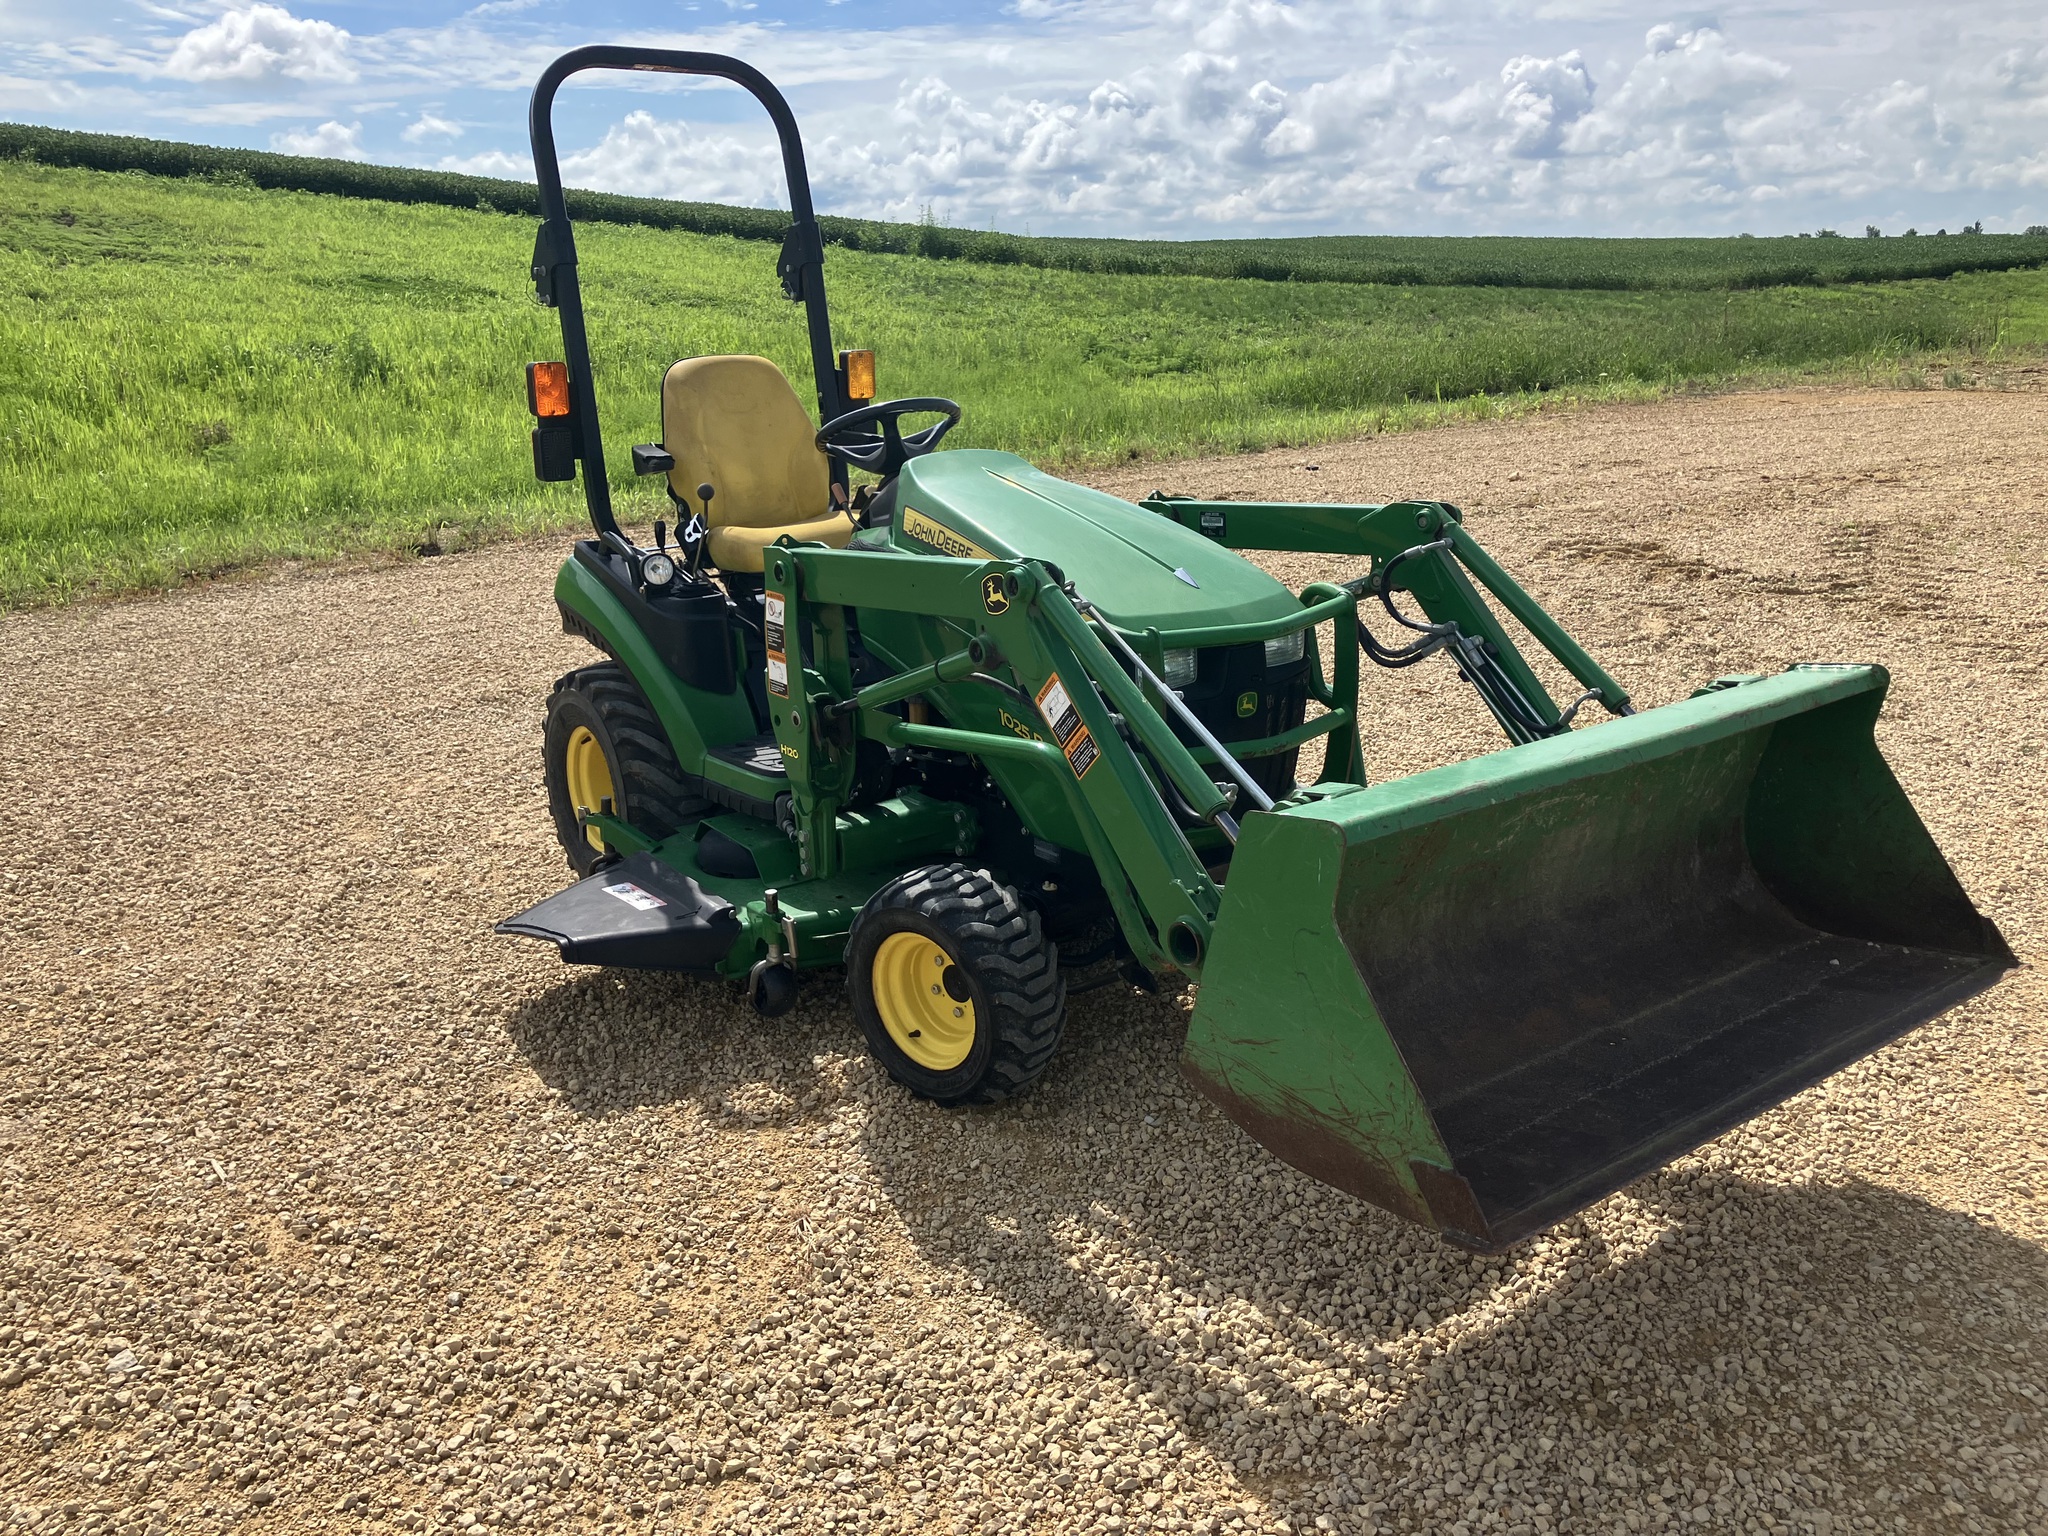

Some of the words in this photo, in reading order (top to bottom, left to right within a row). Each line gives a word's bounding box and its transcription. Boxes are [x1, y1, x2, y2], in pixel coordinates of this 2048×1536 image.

[909, 518, 936, 543] JOHN
[937, 529, 974, 558] DEERE
[780, 744, 799, 758] H120
